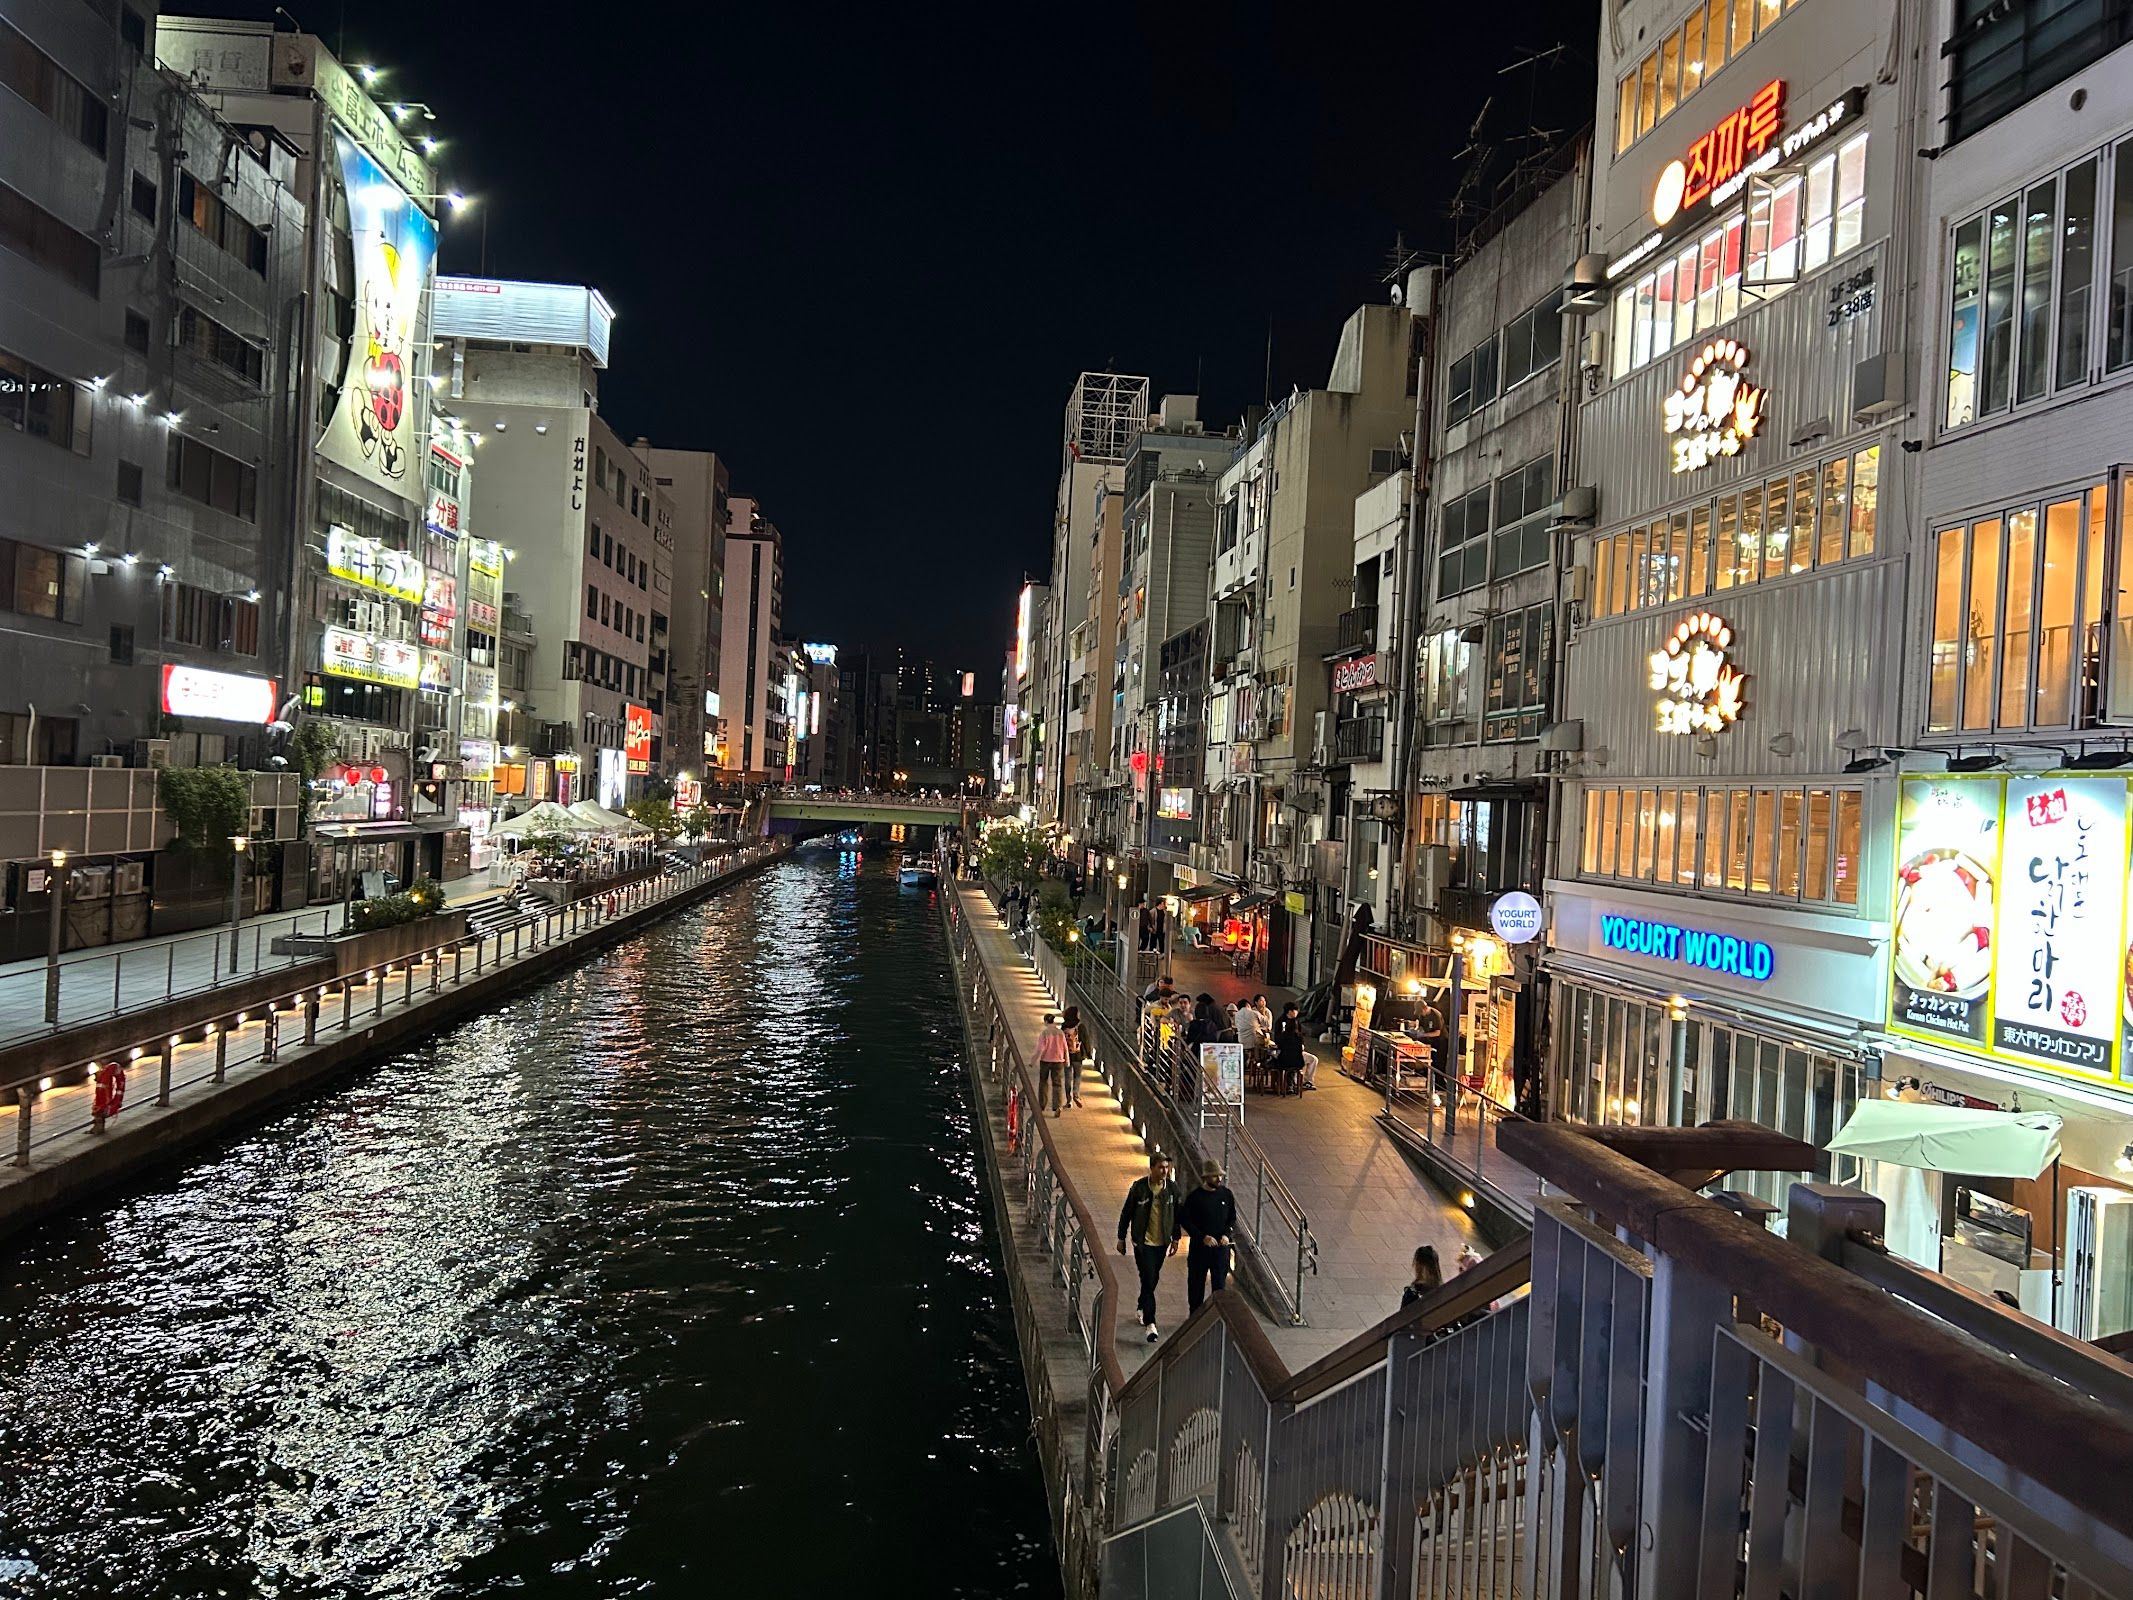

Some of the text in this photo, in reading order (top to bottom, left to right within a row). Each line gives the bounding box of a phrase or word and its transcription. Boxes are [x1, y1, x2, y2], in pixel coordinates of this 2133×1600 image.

[1830, 281, 1845, 303] 1F
[1845, 290, 1872, 317] 38席
[435, 497, 458, 531] 分譲
[1341, 661, 1376, 690] とんかつ
[2027, 788, 2067, 827] 元祖
[1498, 909, 1536, 918] YOGURT
[1500, 919, 1535, 928] WORLD
[1601, 915, 1773, 980] YOGURT WORLD
[2028, 855, 2069, 1012] 닭한마리
[1908, 991, 1969, 1018] タッカンマリ
[1906, 1008, 1970, 1034] Korean Chicken Hot Pot
[2003, 1026, 2105, 1063] 東大門タッカンマリ
